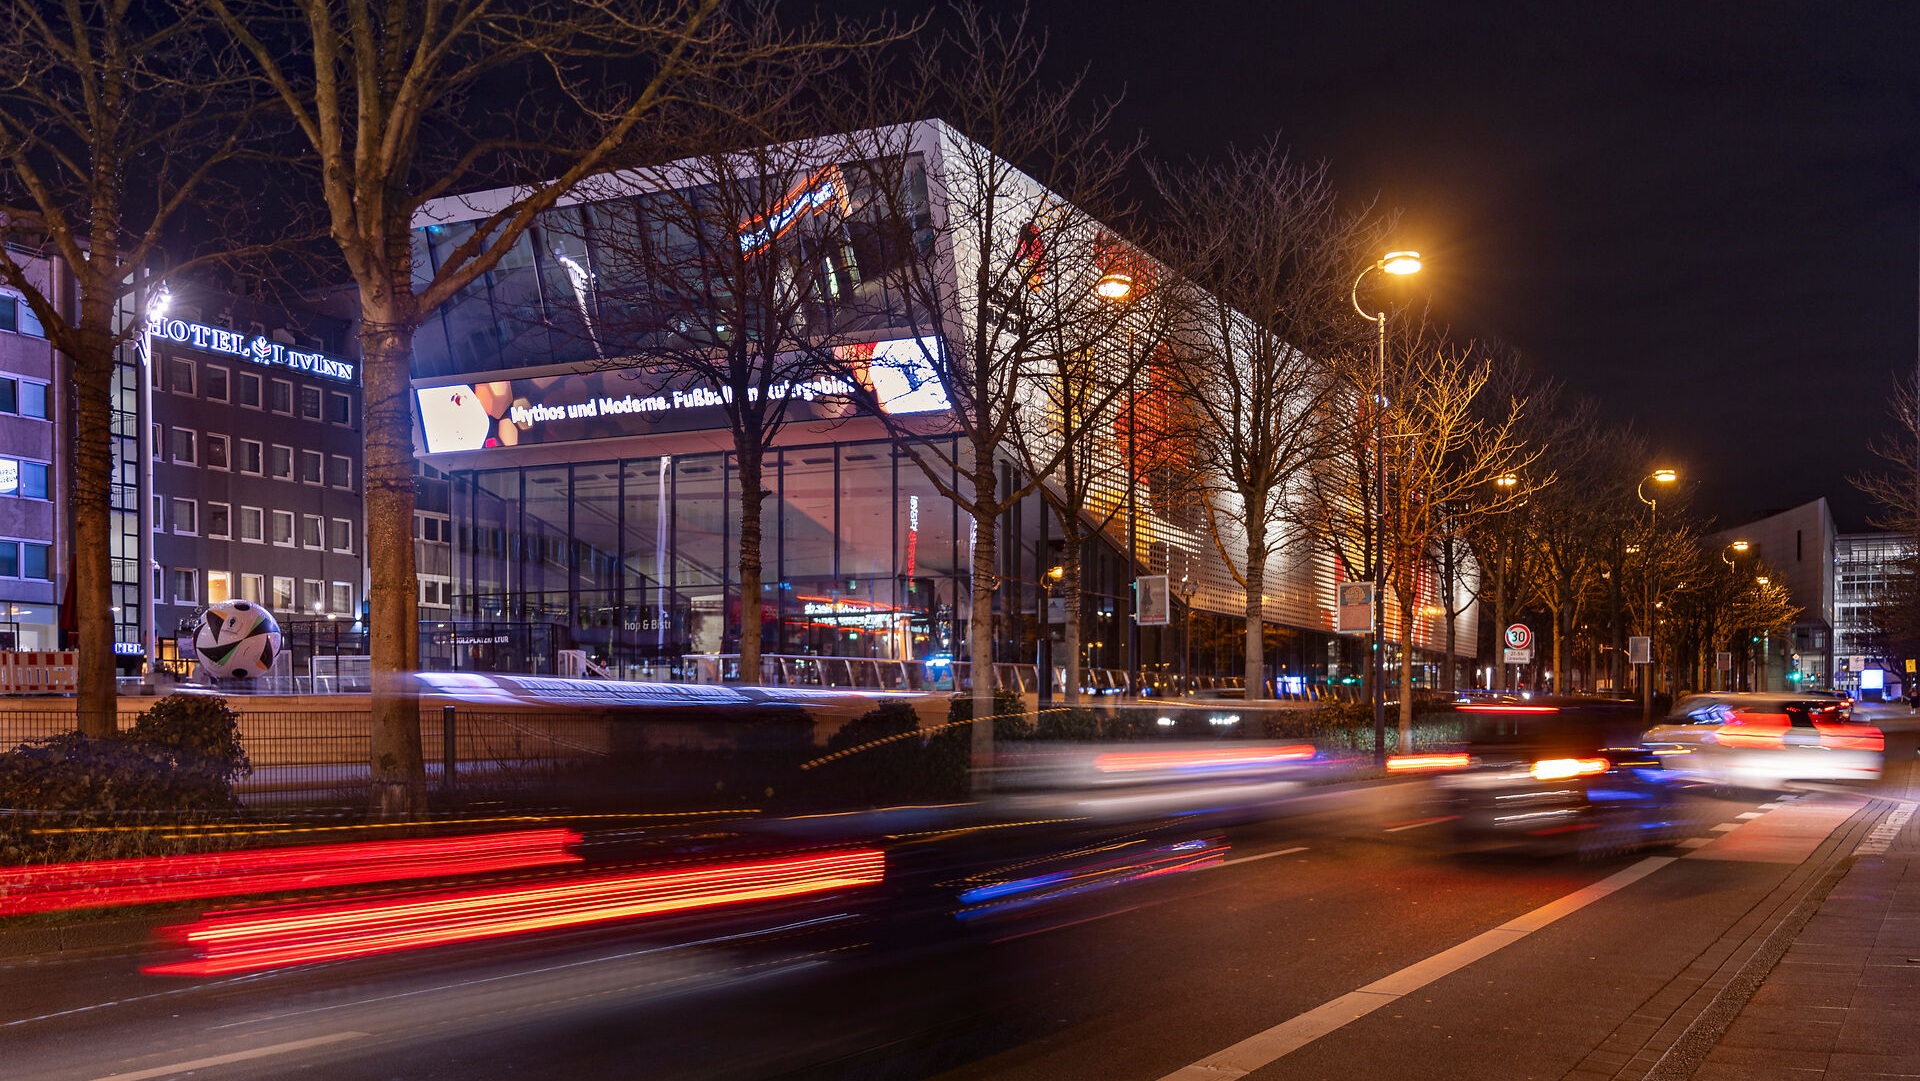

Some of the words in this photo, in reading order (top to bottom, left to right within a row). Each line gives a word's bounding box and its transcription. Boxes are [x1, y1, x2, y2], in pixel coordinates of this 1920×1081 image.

[150, 317, 250, 357] HOTEL
[510, 403, 566, 427] Mythos
[568, 398, 598, 419] und
[598, 394, 671, 416] Moderne.
[673, 385, 733, 408] Fußball
[624, 619, 641, 631] hop
[642, 620, 649, 630] &
[651, 619, 671, 630] Bistr
[1511, 631, 1526, 642] 30
[114, 642, 145, 655] TEL
